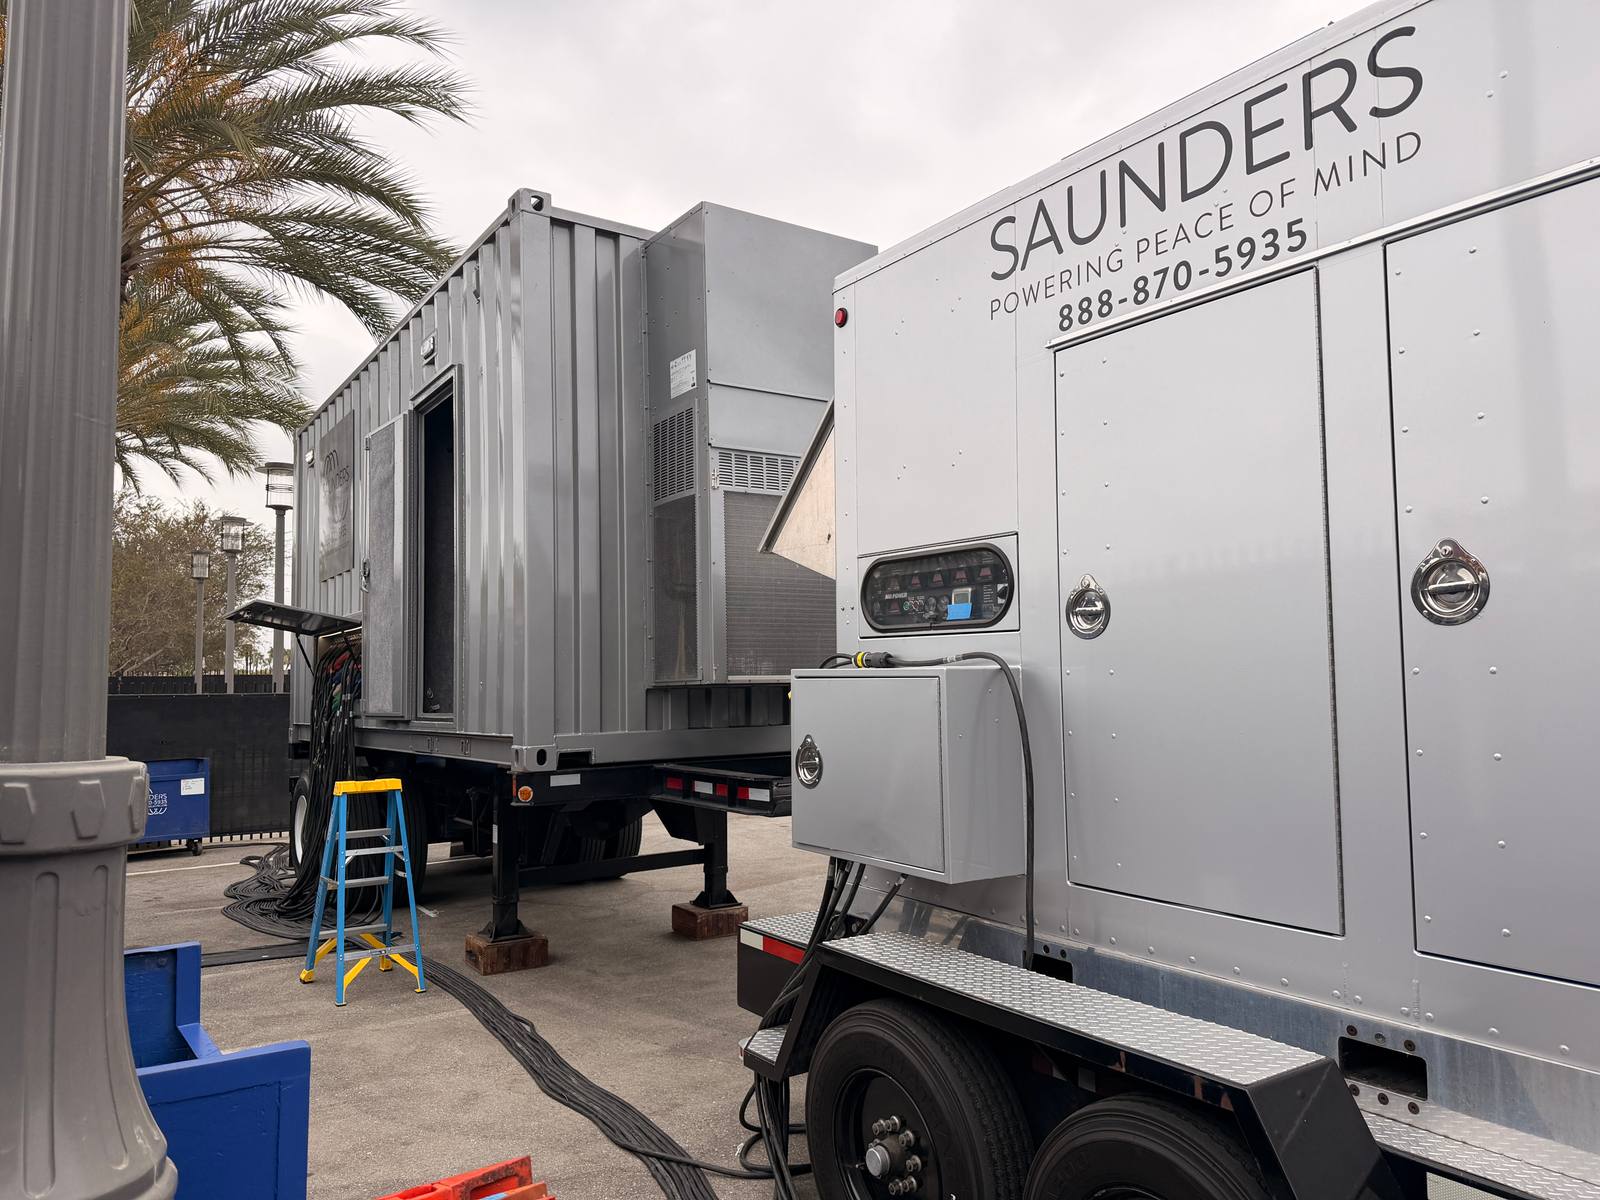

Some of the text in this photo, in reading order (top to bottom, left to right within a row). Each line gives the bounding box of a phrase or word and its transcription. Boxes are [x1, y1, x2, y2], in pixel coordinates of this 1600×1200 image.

[990, 26, 1424, 281] SAUNDERS
[990, 131, 1422, 321] POWERING PEACE OF MIND
[1058, 217, 1308, 332] 888-870-5935
